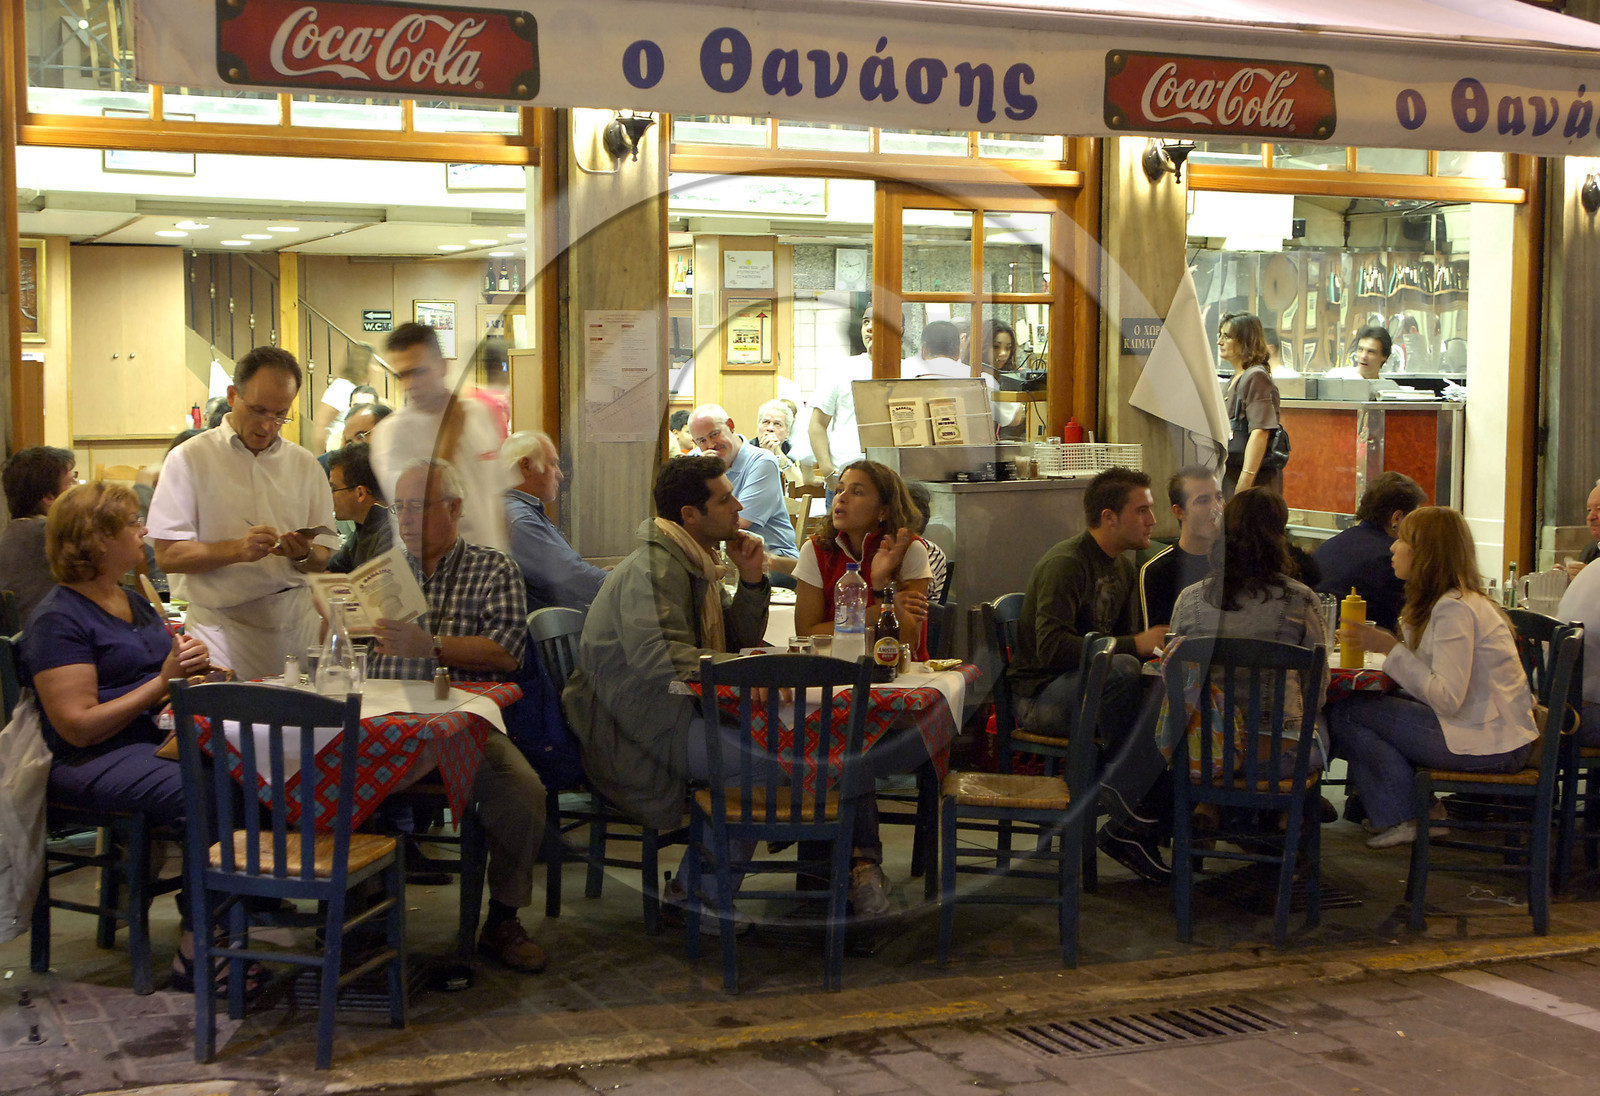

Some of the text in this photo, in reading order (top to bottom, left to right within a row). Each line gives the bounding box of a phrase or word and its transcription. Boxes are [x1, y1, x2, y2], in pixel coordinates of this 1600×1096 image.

[270, 5, 487, 87] Coca-Cola
[1141, 61, 1299, 129] Coca-Cola
[1450, 76, 1600, 140] Θανά
